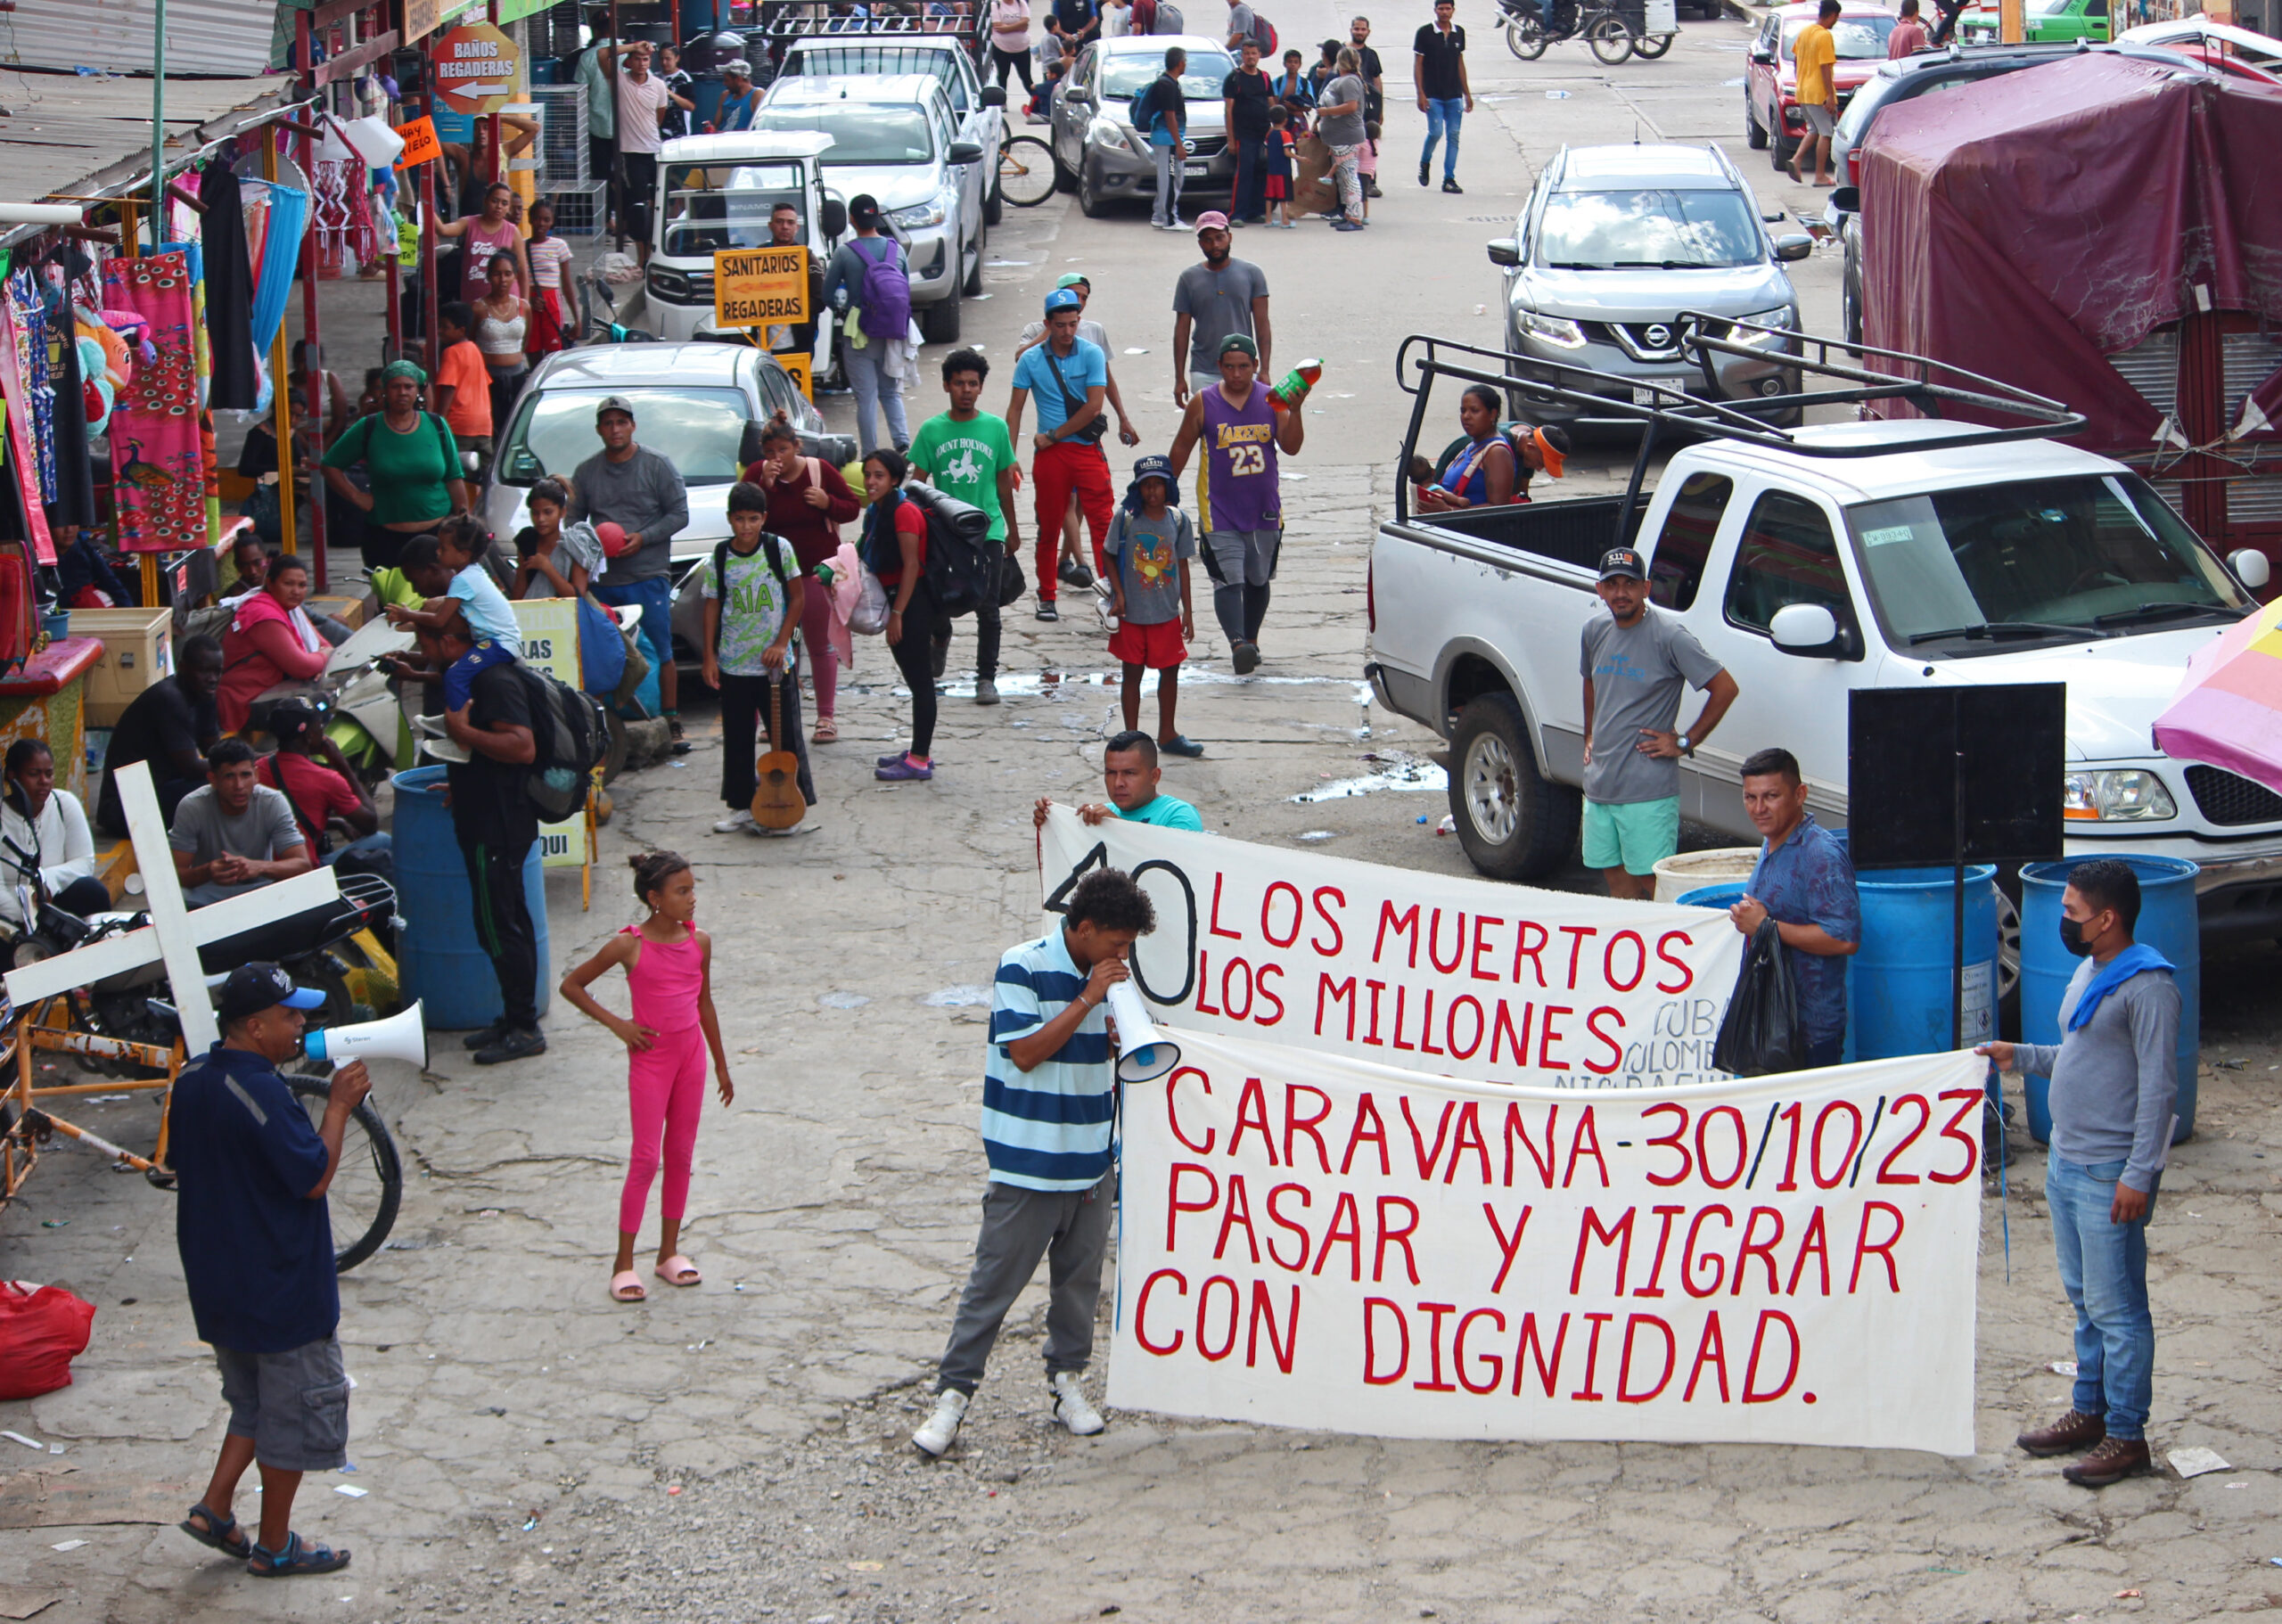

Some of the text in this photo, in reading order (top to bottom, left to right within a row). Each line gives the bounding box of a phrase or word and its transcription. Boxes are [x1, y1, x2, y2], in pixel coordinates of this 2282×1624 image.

[454, 39, 498, 59] BAÑOS
[439, 60, 514, 78] REGADERAS
[400, 126, 422, 138] HAY
[722, 254, 800, 277] SANITARIOS
[723, 297, 802, 321] REGADERAS
[959, 438, 994, 461] HOLYOKE
[1216, 422, 1272, 449] LAKERS
[1228, 444, 1267, 478] 23
[731, 583, 775, 614] AIA
[1210, 872, 1694, 995] LOS MUERTOS
[1195, 950, 1626, 1075] LOS MILLONES
[1167, 1067, 1985, 1192] CARAVANA-30/10/23
[1167, 1163, 1904, 1298] PASAR Y MIGRAR
[1136, 1269, 1818, 1405] CON DIGNIDAD.
